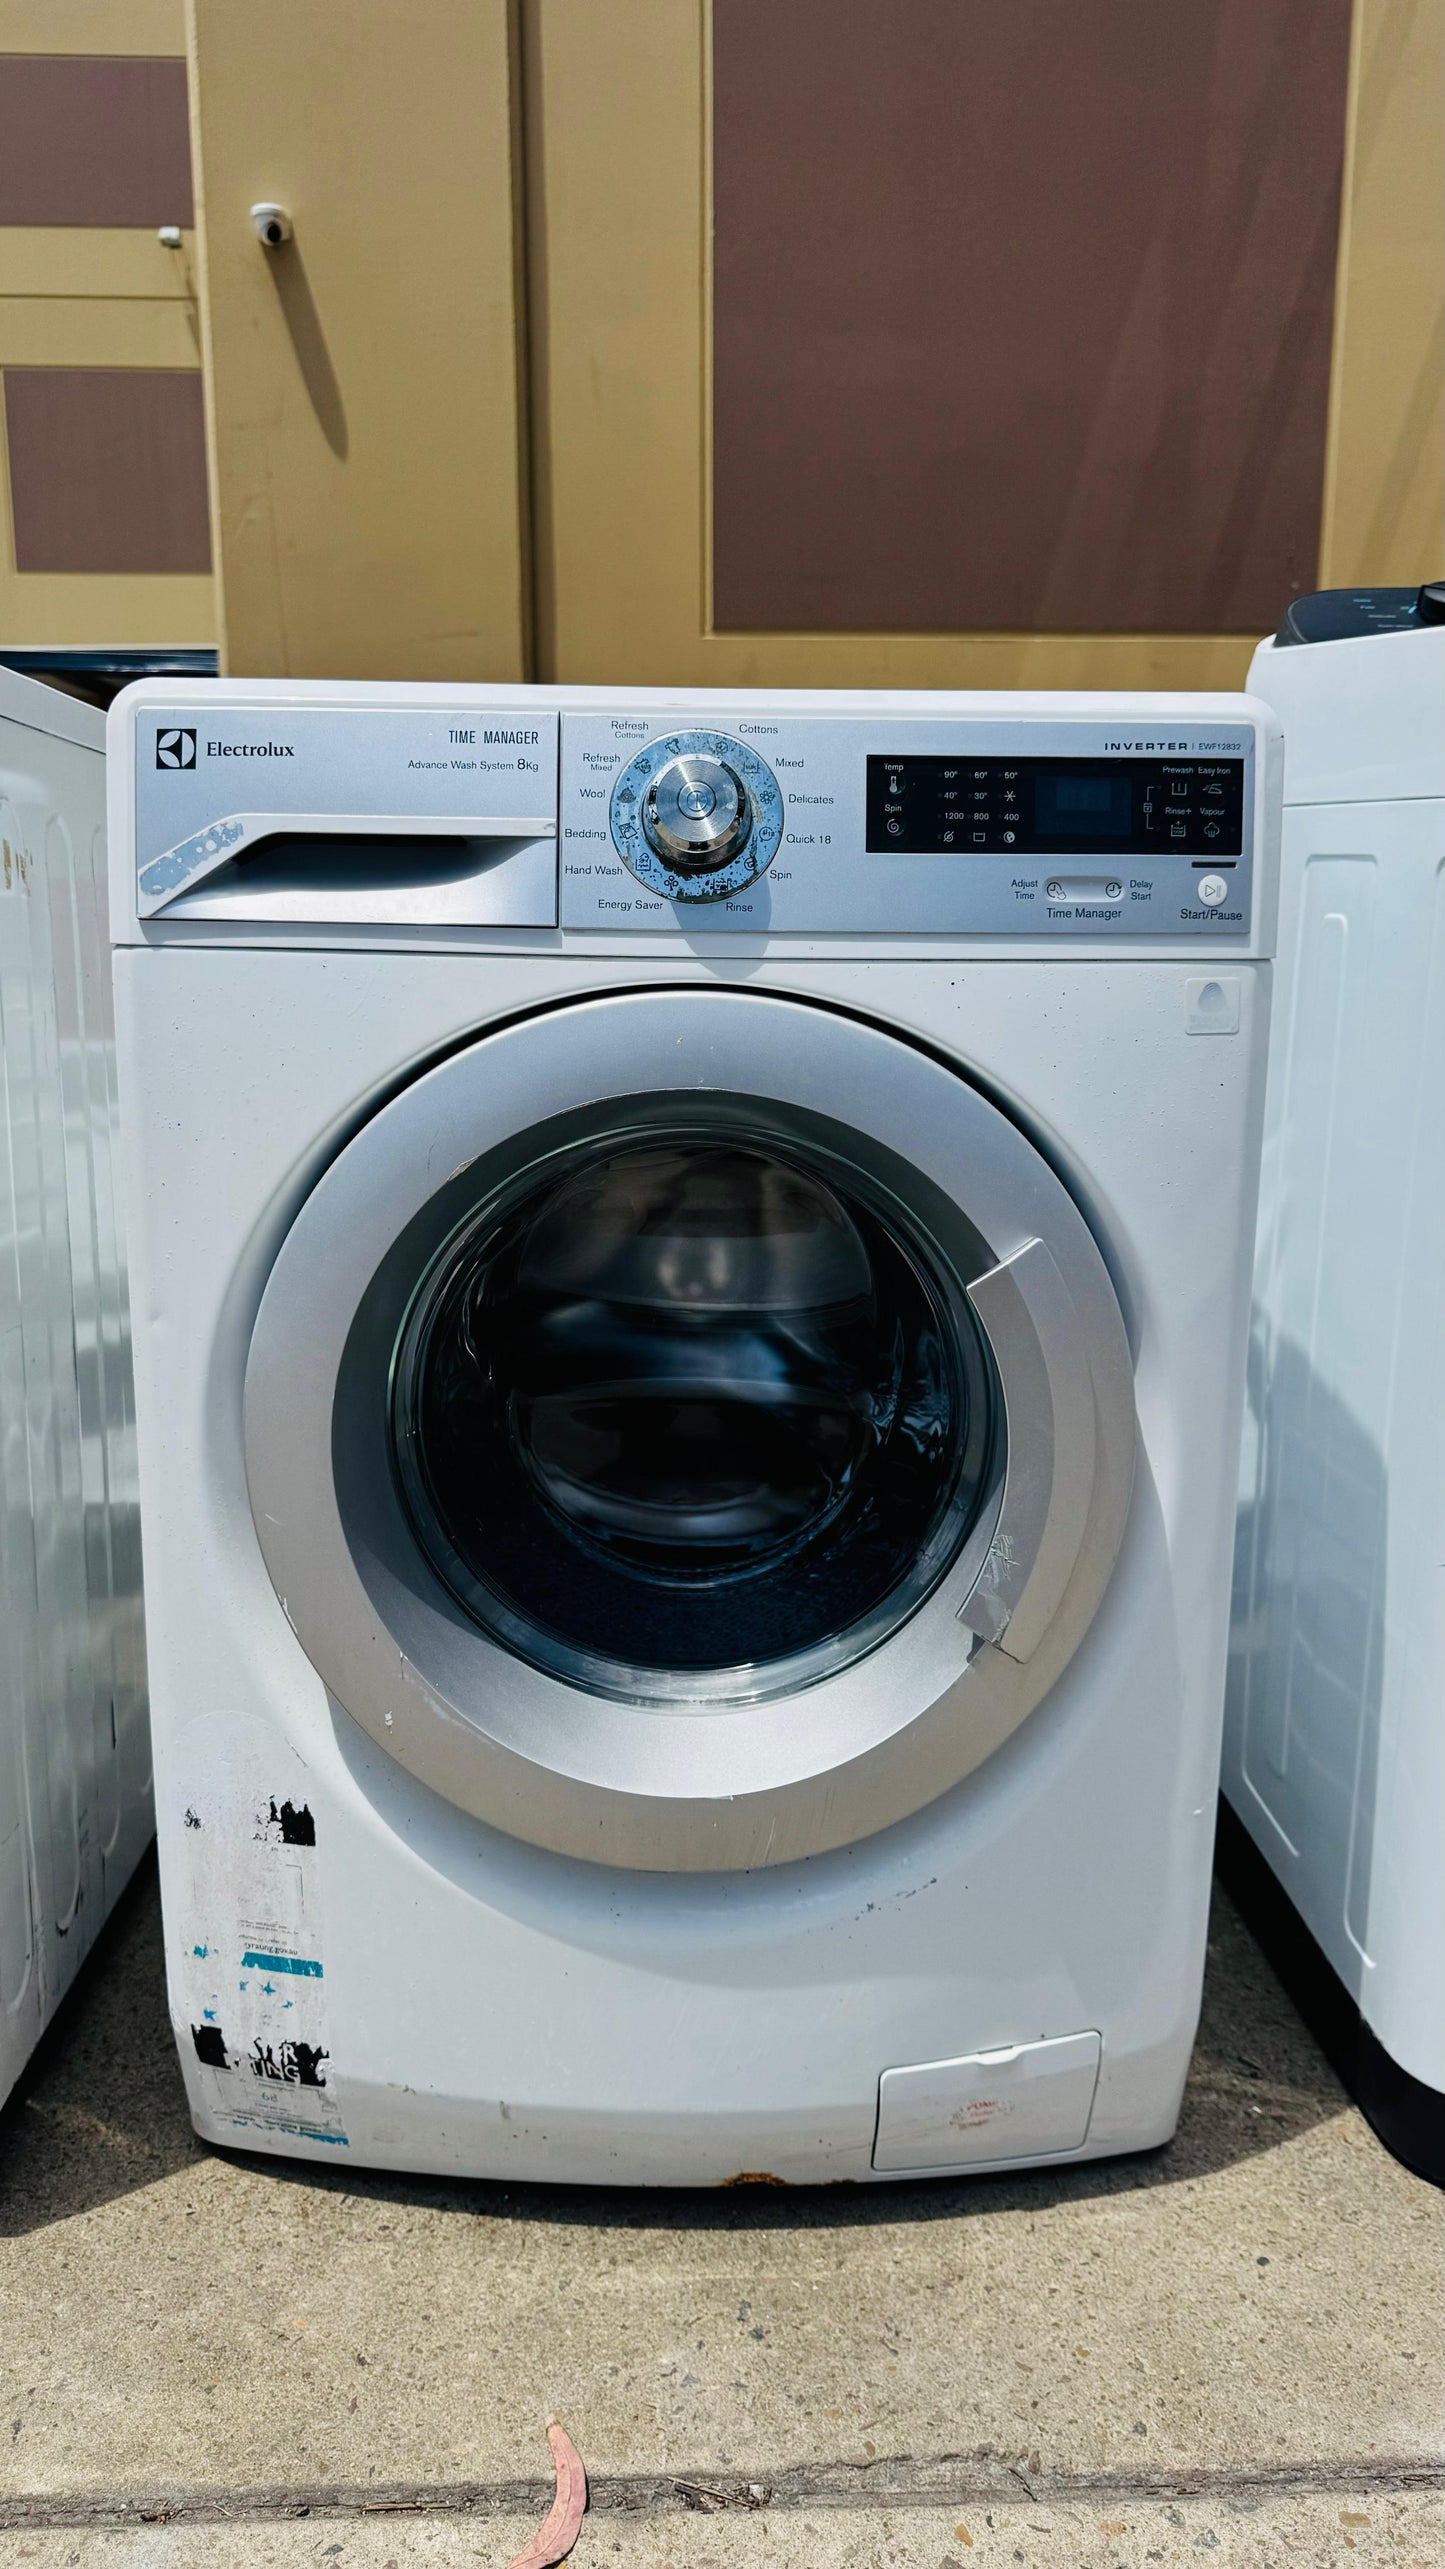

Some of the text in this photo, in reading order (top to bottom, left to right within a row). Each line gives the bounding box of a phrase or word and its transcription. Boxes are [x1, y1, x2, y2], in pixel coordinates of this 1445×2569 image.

[611, 720, 649, 731] Refresh
[739, 724, 778, 735] Cottons
[448, 730, 539, 745] TIME MANAGER
[615, 731, 645, 740] Cottons
[206, 741, 296, 758] Electrolux
[1105, 742, 1188, 751] INVERTER
[583, 753, 621, 764] Refresh
[775, 758, 804, 768] Mixed
[408, 758, 539, 773] Advance Wash System 8Kg
[590, 763, 613, 772] Mixed
[884, 763, 904, 772] Temp
[1162, 766, 1194, 774] Prewash
[1198, 766, 1231, 776] Easy Iron
[579, 789, 606, 799] Wool
[788, 794, 834, 804] Delicates
[884, 804, 902, 813] Spin
[1165, 807, 1192, 815] Rinse+
[1200, 807, 1225, 816] Vapour
[944, 812, 964, 820] 1200
[1004, 813, 1020, 821] 400
[564, 829, 606, 841] Bedding
[786, 833, 831, 845] Quick 18
[565, 865, 623, 876] Hand Wash
[769, 869, 792, 882] Spin
[1011, 879, 1038, 889] Adjust
[1129, 879, 1153, 890] Delay
[1014, 891, 1035, 900] Time
[1130, 892, 1151, 901] Start
[598, 899, 663, 911] Energy Saver
[726, 902, 753, 912] Rinse
[1046, 908, 1122, 920] Time Manager
[1180, 908, 1243, 921] Start/Pause
